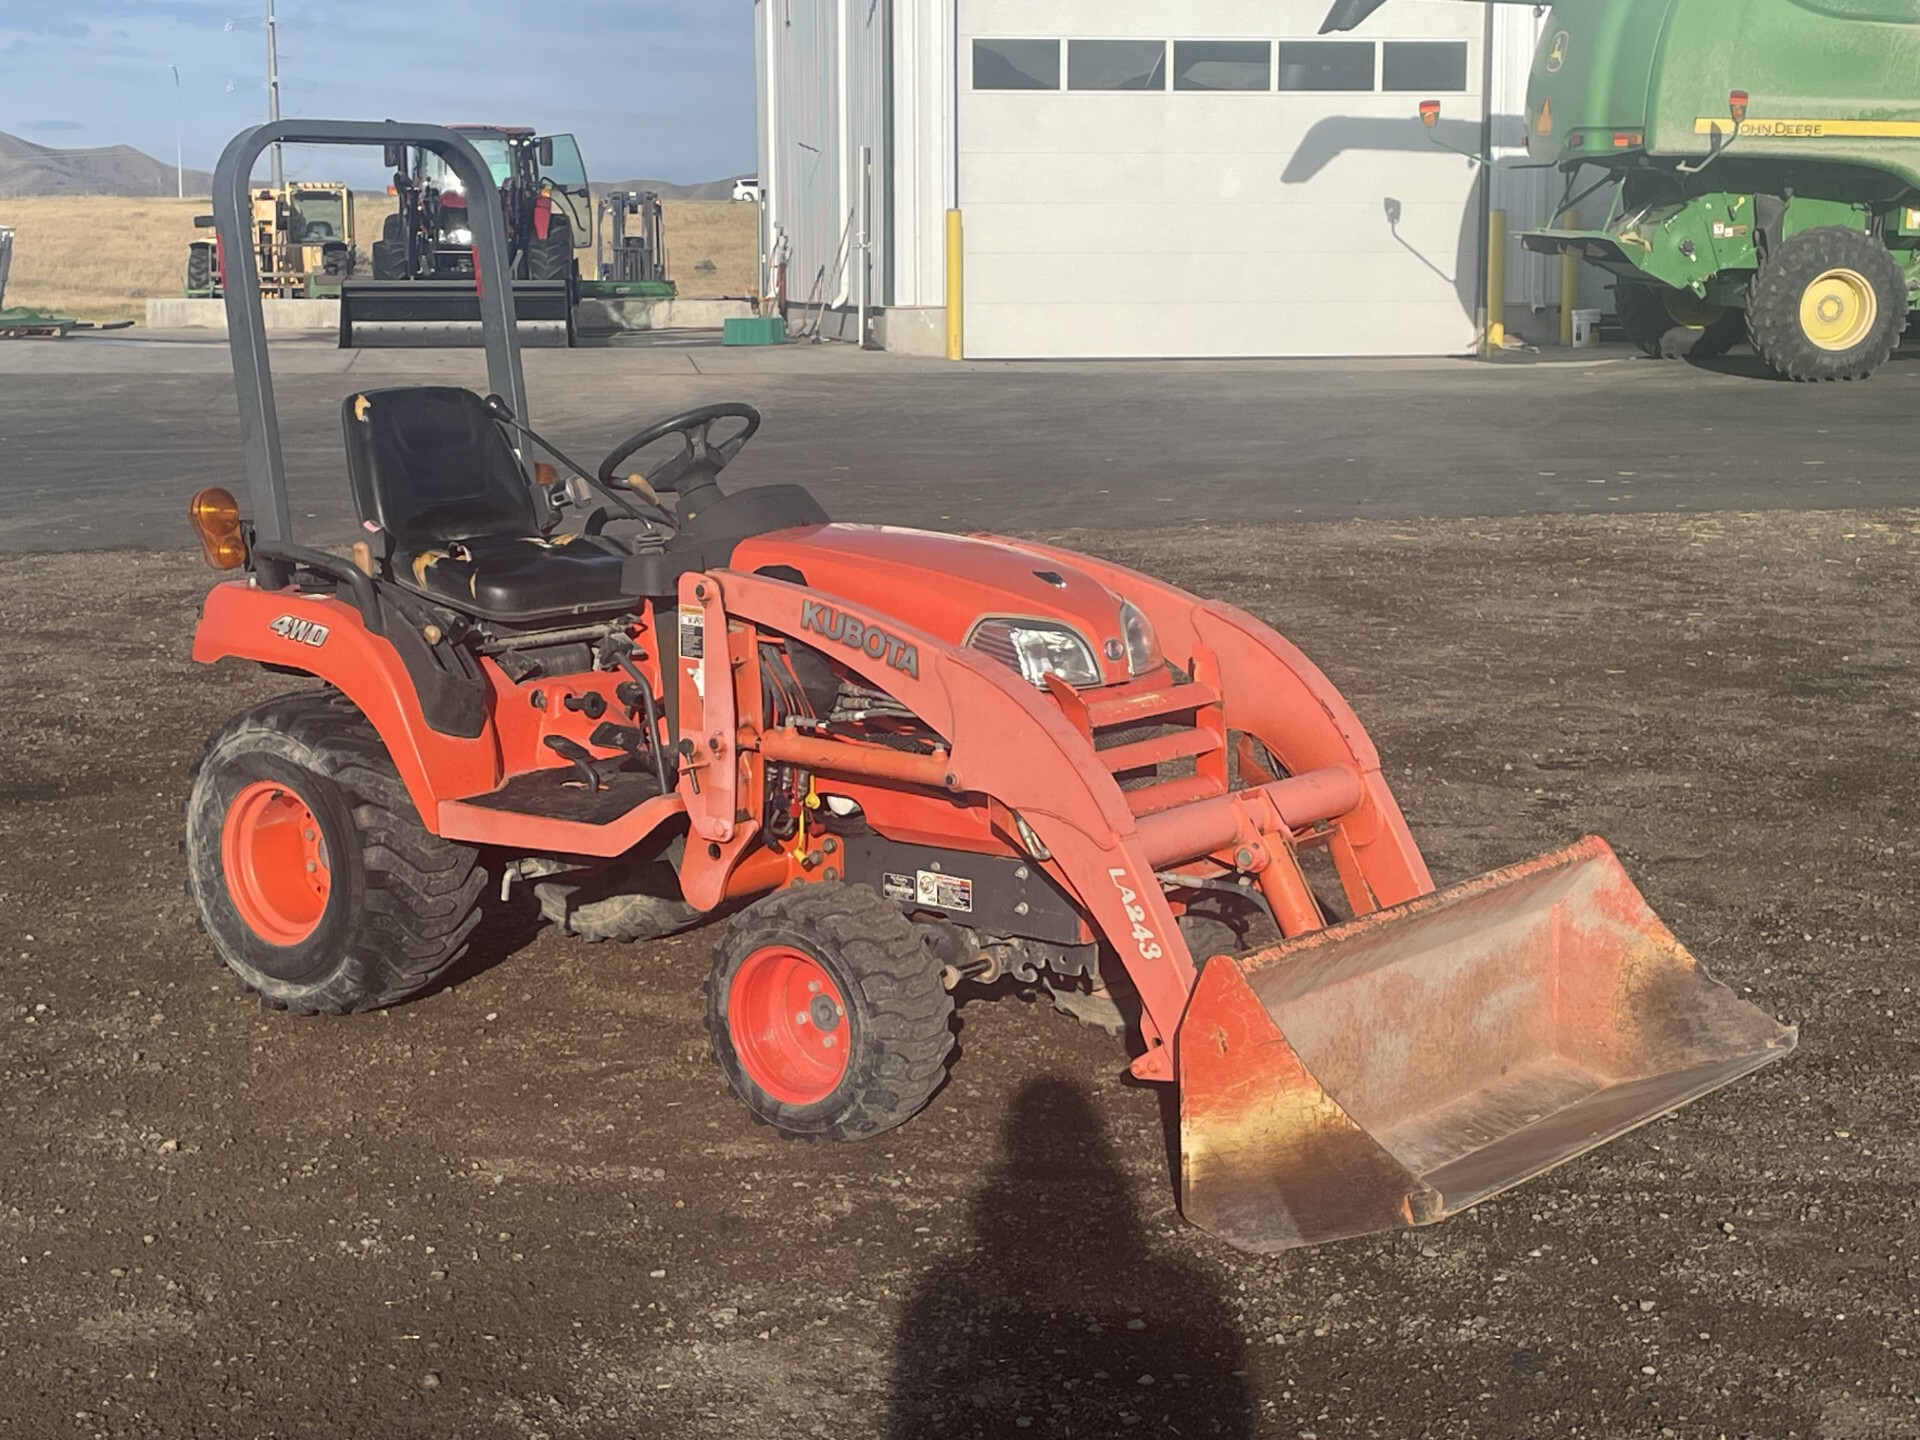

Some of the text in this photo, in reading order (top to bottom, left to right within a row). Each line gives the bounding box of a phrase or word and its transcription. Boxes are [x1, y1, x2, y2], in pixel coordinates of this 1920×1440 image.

[1737, 122, 1823, 135] OHN DEERE
[269, 614, 330, 647] 4WD
[801, 599, 919, 681] KUBOTA
[1108, 868, 1163, 960] LA243
